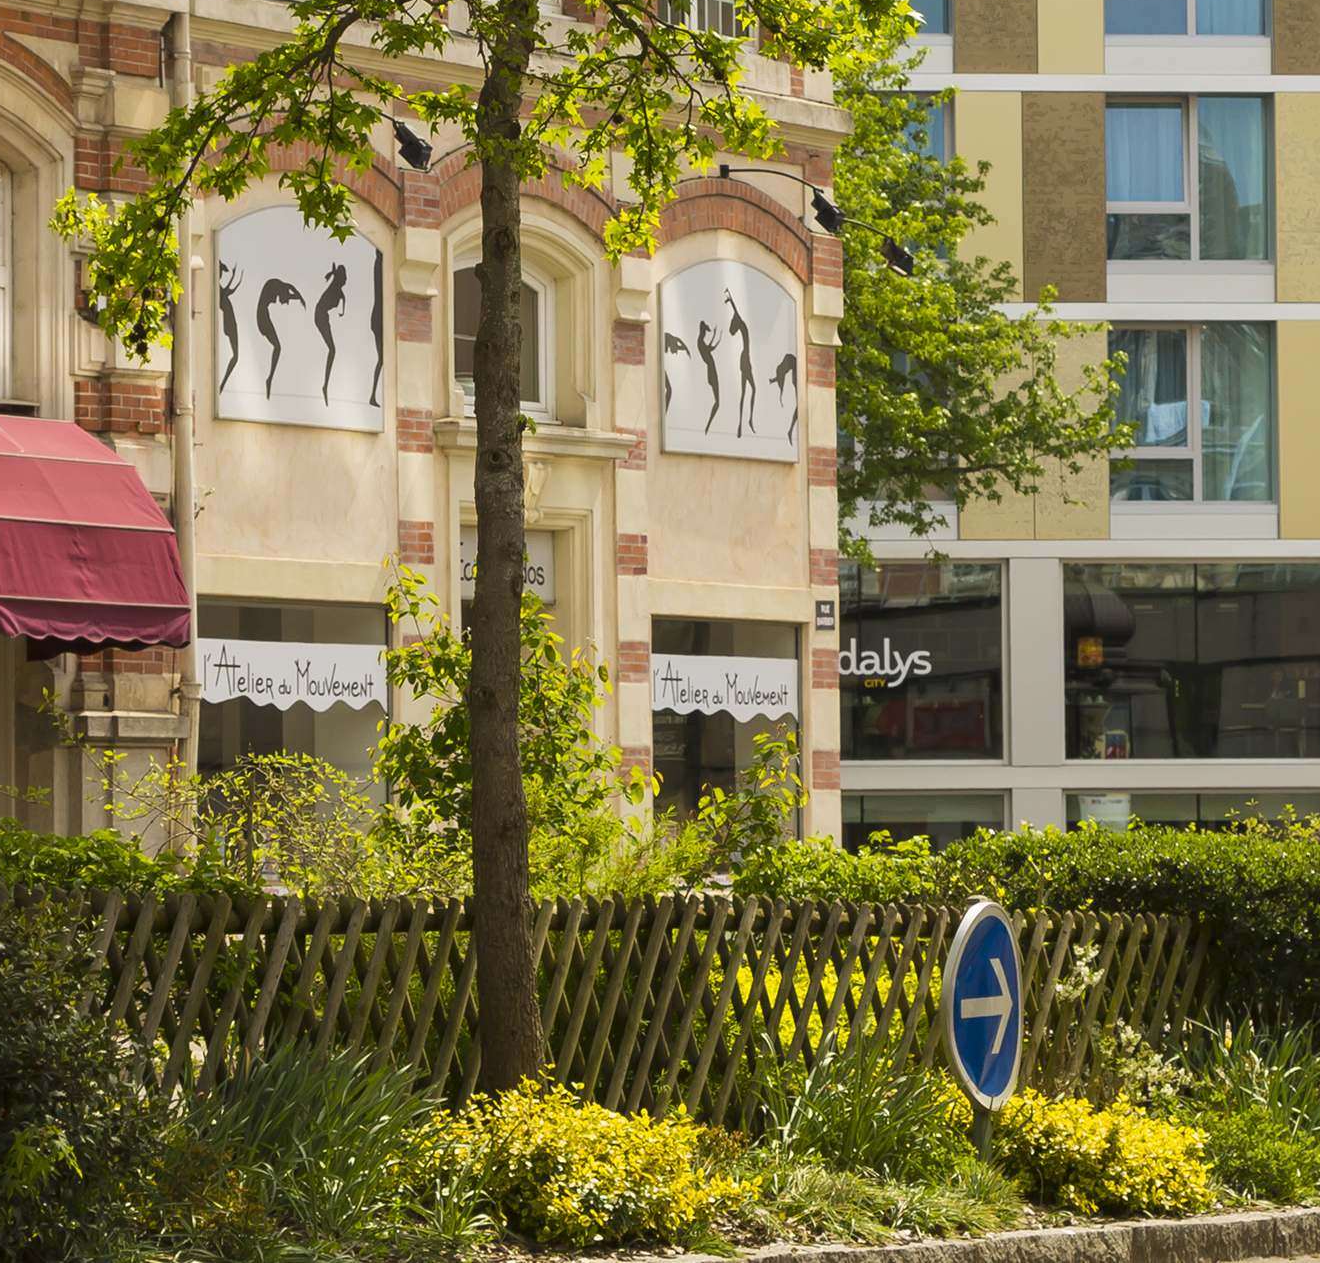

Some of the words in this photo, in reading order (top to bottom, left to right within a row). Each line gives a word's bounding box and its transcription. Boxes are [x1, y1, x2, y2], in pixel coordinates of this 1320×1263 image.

[837, 637, 932, 688] dalys
[278, 679, 292, 695] du
[864, 678, 886, 688] CITY
[711, 689, 723, 705] du
